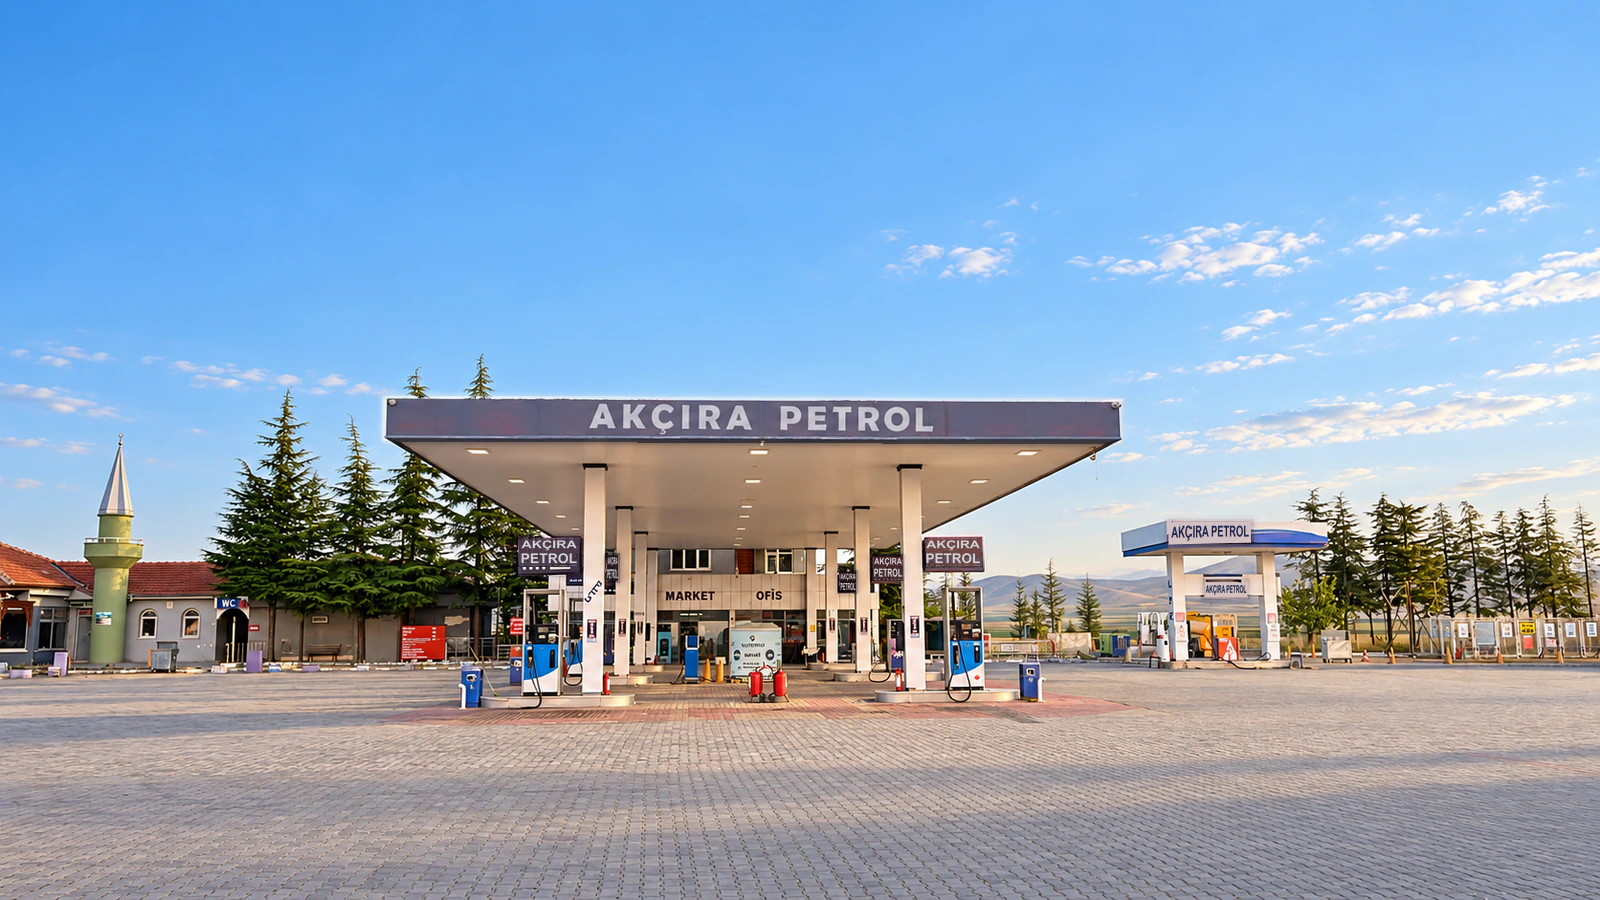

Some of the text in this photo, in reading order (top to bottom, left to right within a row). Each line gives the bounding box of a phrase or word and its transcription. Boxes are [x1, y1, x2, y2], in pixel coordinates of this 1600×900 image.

[589, 403, 934, 435] AKÇIRA PETROL
[1171, 525, 1249, 541] AKÇIRA PETROL
[521, 540, 577, 551] AKÇIRA
[926, 540, 980, 551] AKÇIRA
[521, 553, 578, 564] PETROL
[873, 557, 902, 567] AKÇIRA
[926, 553, 980, 564] PETROL
[873, 568, 903, 578] PETROL
[840, 582, 856, 591] PETROL
[1205, 584, 1226, 595] AKÇIRA
[1226, 584, 1247, 594] PETROL
[665, 591, 715, 601] MARKET
[756, 588, 783, 601] OFİS
[221, 599, 236, 608] WC
